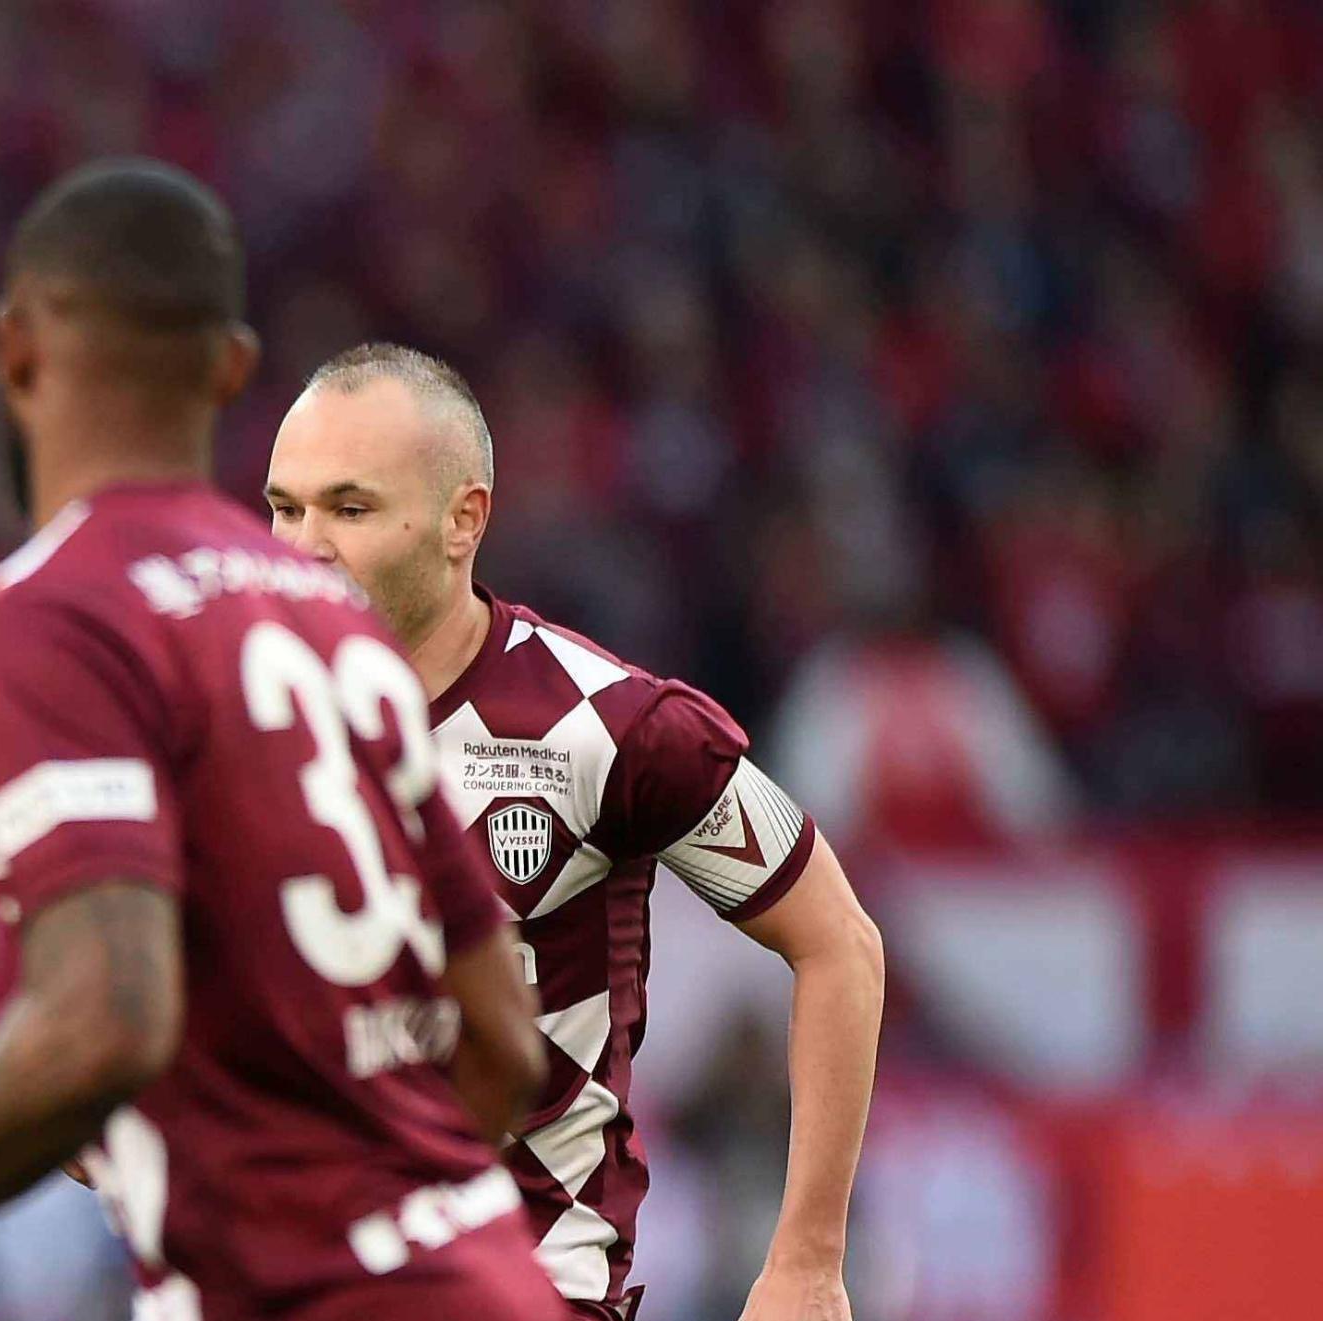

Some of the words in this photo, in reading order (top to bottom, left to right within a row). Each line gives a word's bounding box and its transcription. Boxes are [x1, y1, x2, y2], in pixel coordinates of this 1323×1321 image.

[464, 743, 519, 759] Rakuten
[521, 746, 570, 763] Medical
[463, 780, 532, 792] CONQUERING
[694, 819, 714, 838] WE
[713, 795, 732, 821] ARE
[710, 811, 732, 836] ONE
[509, 835, 546, 846] VISSEL
